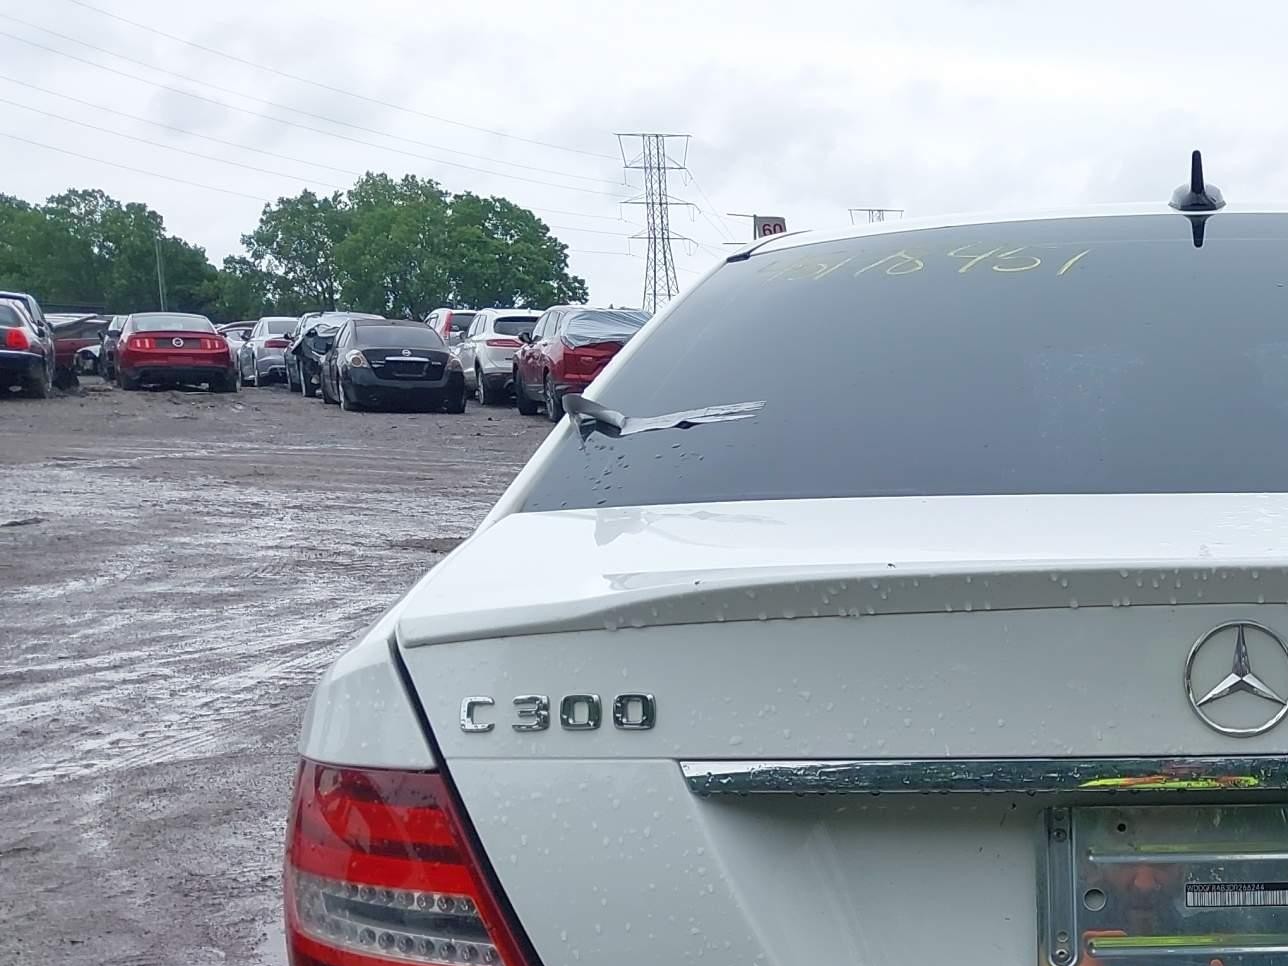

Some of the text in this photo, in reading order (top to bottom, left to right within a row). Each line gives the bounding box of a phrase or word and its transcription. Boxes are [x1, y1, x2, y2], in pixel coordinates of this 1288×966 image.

[762, 223, 784, 236] 60
[460, 693, 657, 733] C 300
